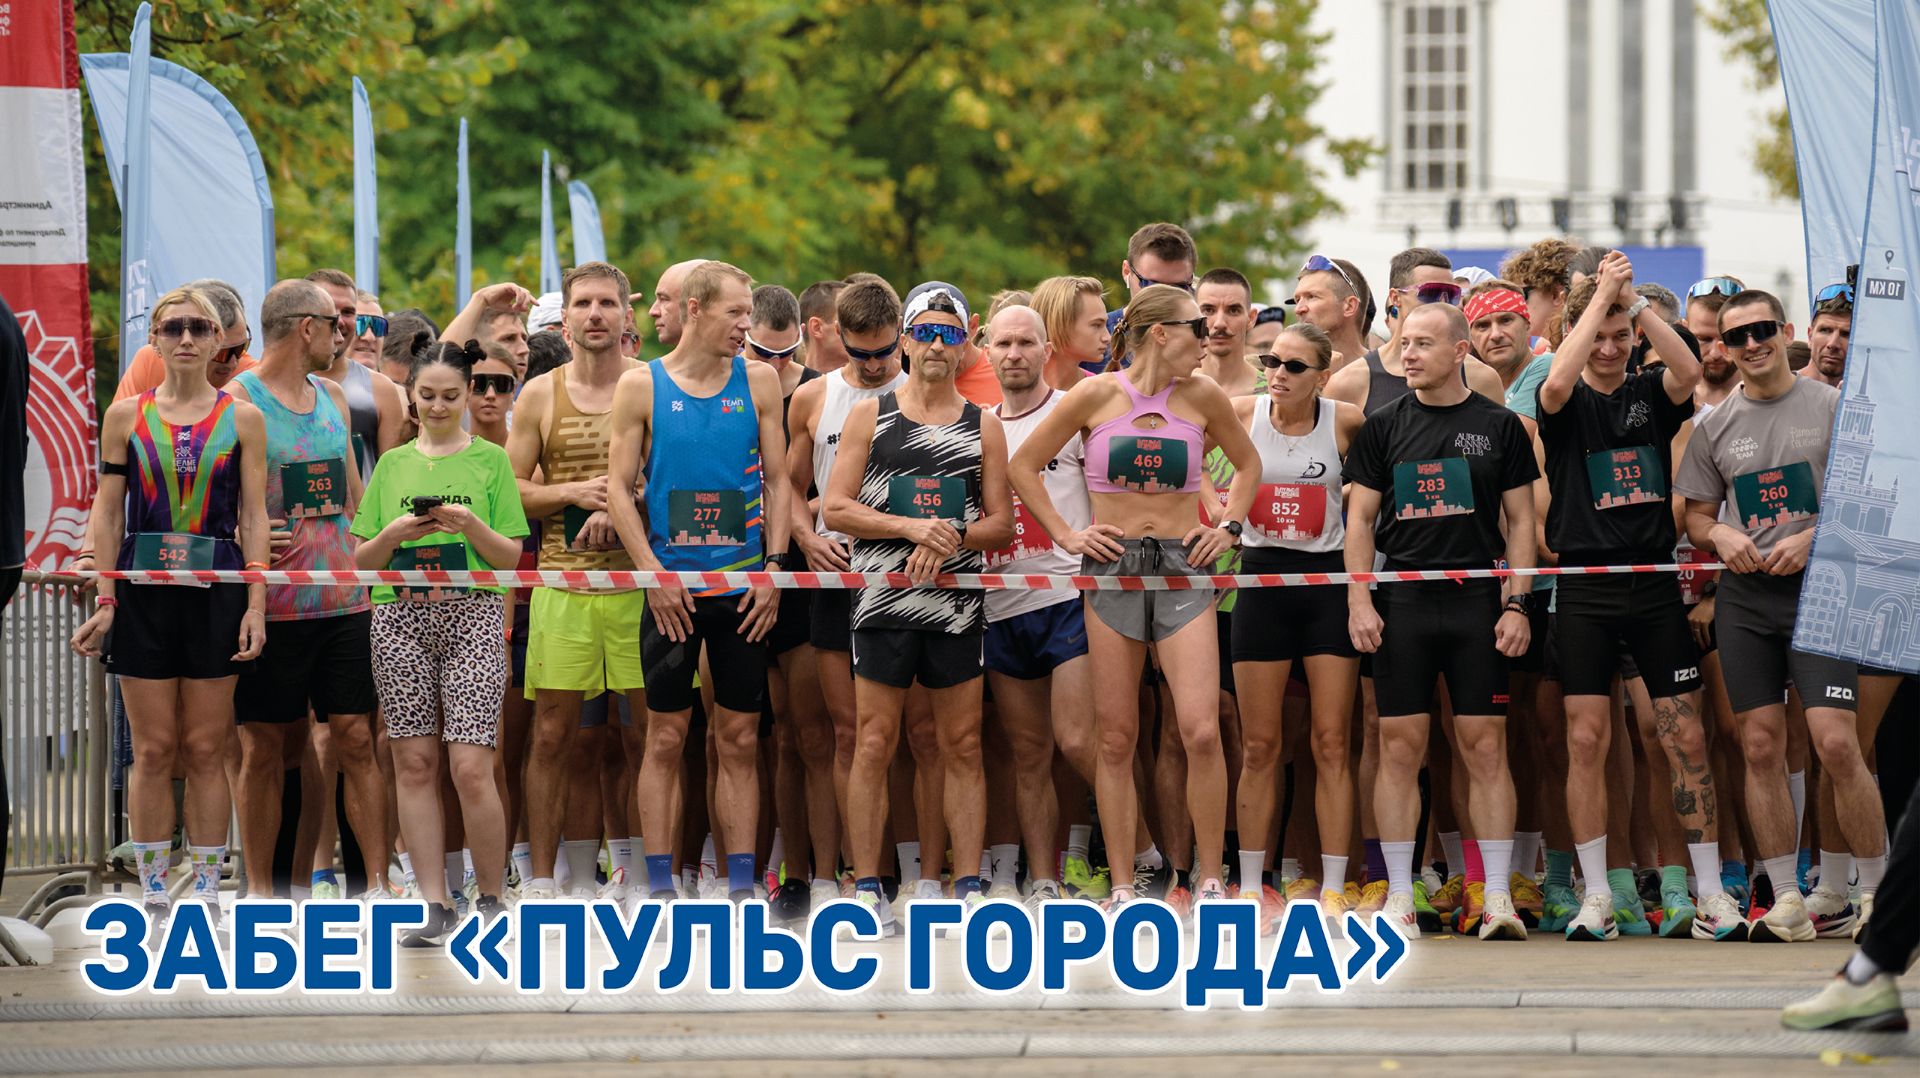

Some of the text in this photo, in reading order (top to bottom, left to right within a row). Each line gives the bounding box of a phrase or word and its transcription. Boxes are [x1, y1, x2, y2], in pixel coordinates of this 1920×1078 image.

[722, 399, 744, 407] ТЕМП
[1455, 440, 1492, 451] RUNNING
[1456, 432, 1490, 445] AURORA
[1133, 453, 1163, 469] 469
[1613, 465, 1642, 481] 313
[307, 477, 332, 493] 263
[1417, 477, 1446, 493] 283
[912, 493, 942, 507] 456
[1759, 485, 1788, 503] 260
[693, 508, 722, 521] 277
[1271, 502, 1300, 516] 852
[159, 547, 189, 562] 542
